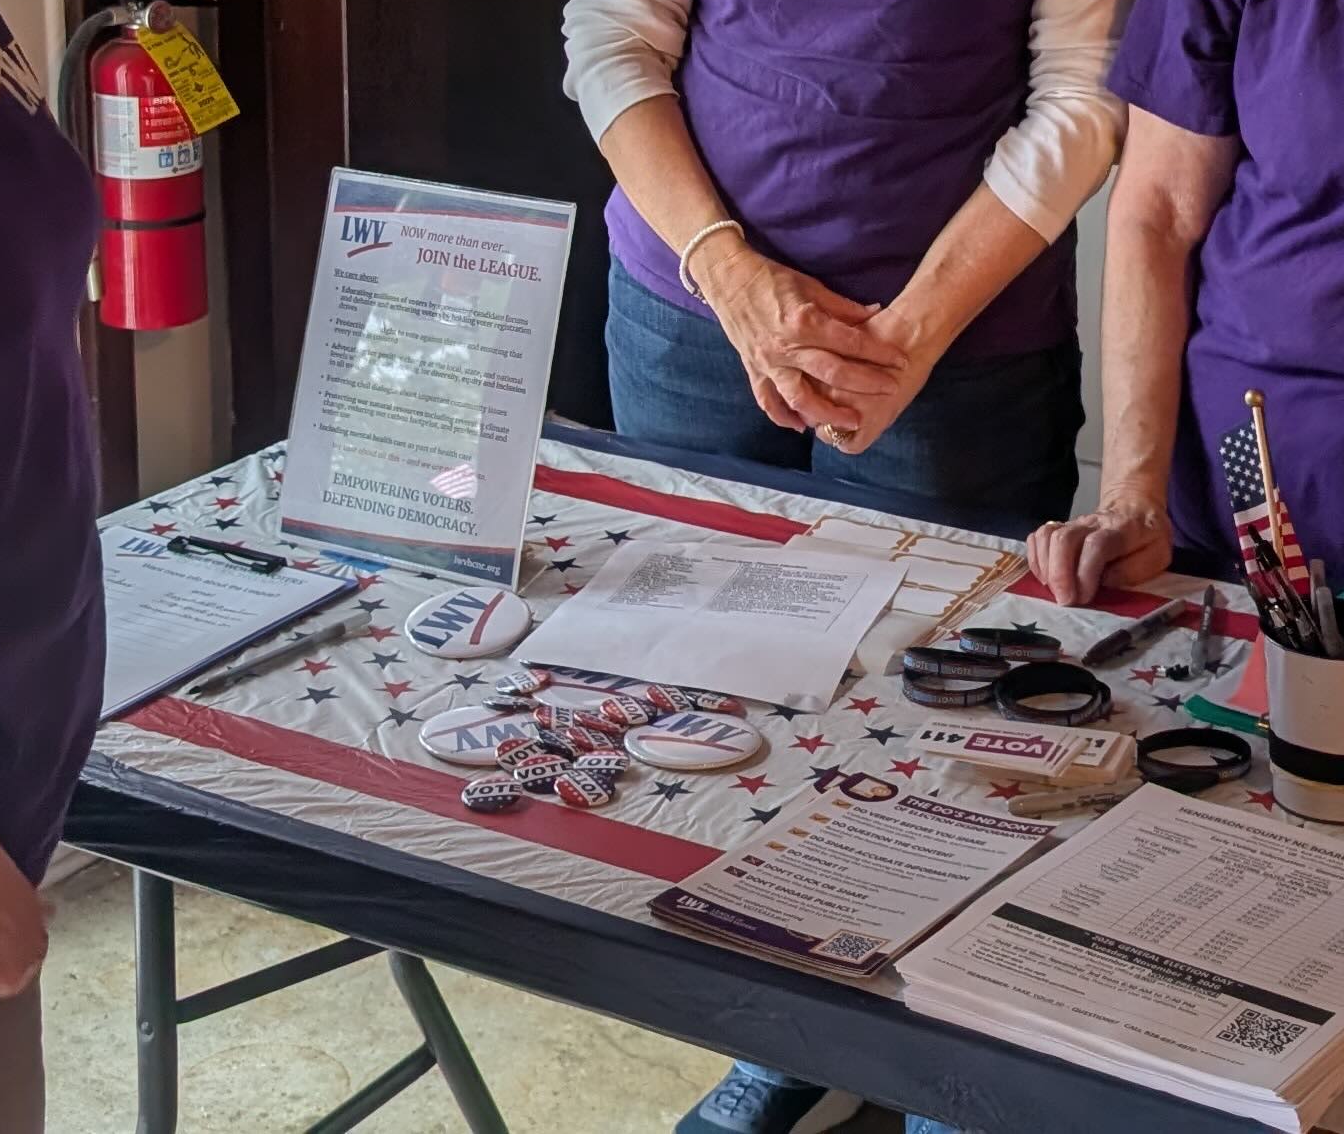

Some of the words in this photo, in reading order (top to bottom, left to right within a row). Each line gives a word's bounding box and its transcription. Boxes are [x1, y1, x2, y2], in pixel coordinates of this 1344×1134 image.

[341, 216, 386, 244] LWV
[400, 226, 427, 240] NOW
[427, 232, 454, 245] more
[456, 235, 479, 249] than
[416, 248, 451, 265] JOIN
[454, 255, 476, 271] the
[479, 258, 542, 282] LEAGUE.
[332, 472, 420, 502] EMPOWERING
[423, 491, 474, 514] VOTERS.
[323, 490, 395, 517] DEFENDING
[397, 507, 478, 536] DEMOCRACY.
[410, 591, 490, 650] LWV
[557, 707, 570, 728] VOTE
[618, 696, 643, 720] VOTE
[653, 714, 754, 745] LWV
[920, 730, 965, 743] 411
[973, 737, 1042, 754] VOTE
[518, 762, 574, 780] VOTE
[576, 757, 626, 767] VOTE
[466, 784, 521, 796] VOTE
[568, 771, 604, 802] VOTE
[894, 805, 908, 813] OF
[909, 809, 955, 825] ELECTION
[955, 822, 1039, 841] DISINFORMATION
[906, 798, 930, 810] THE
[931, 805, 965, 817] DO'S
[966, 814, 996, 826] AND
[997, 821, 1049, 834] DON'TS
[1178, 807, 1246, 830] HENDERSON
[1245, 825, 1292, 845] COUNTY
[1293, 838, 1312, 850] NC
